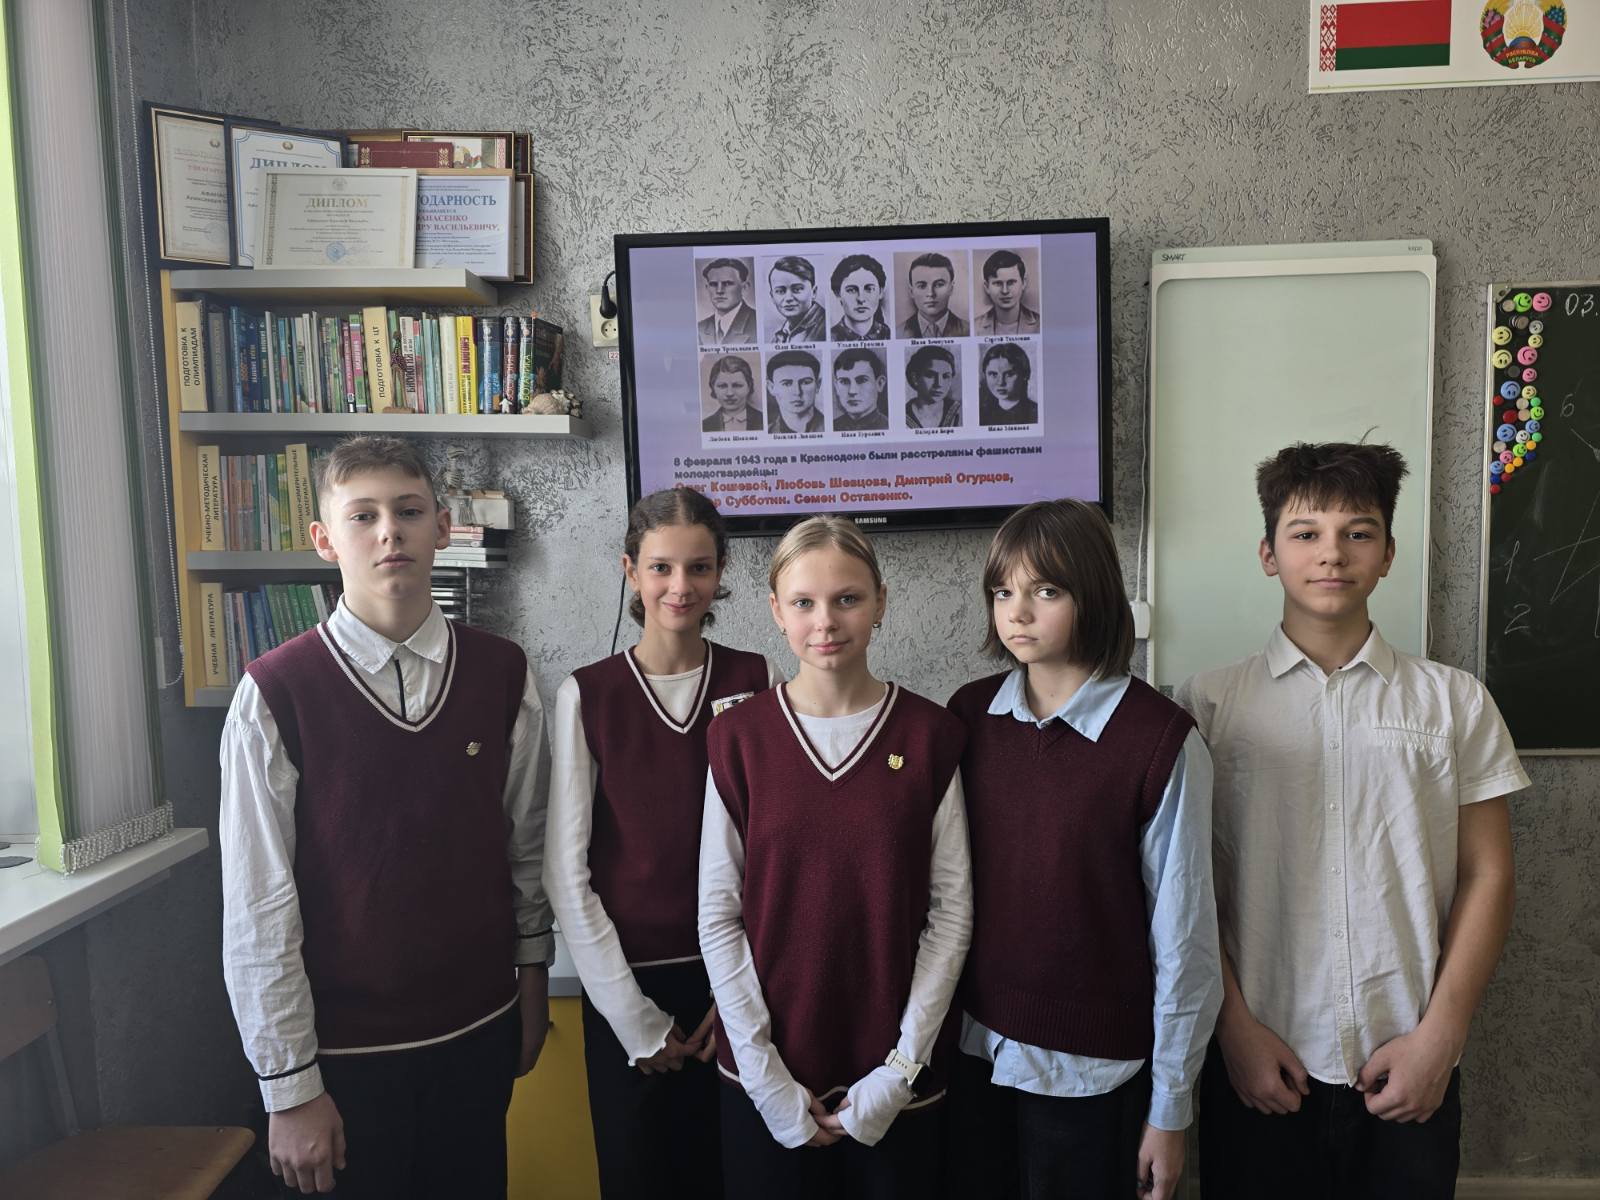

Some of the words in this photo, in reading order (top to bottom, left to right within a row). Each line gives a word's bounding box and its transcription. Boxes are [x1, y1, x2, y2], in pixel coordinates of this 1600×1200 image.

[249, 157, 328, 169] ДИПЛ
[305, 197, 369, 209] ДИПЛОМ
[417, 194, 497, 206] ОДАРНОСТЬ
[1161, 253, 1186, 262] SMART
[373, 326, 379, 336] ЦТ
[181, 335, 191, 387] ПОДГОТОВКА
[190, 327, 201, 386] ОЛИМПИАДАМ
[374, 347, 386, 398] ПОДГОТОВКА
[404, 353, 416, 393] БИОЛОГИЯ
[523, 354, 532, 401] БОТАНИКА
[673, 457, 680, 466] 8
[683, 455, 732, 468] февраля
[735, 454, 760, 465] 1943
[764, 455, 788, 466] года
[800, 452, 866, 464] Краснодоне
[868, 450, 898, 461] были
[901, 448, 973, 461] расстреляны
[976, 446, 1042, 458] фашистами
[674, 468, 778, 480] молодогвардейцы:
[711, 479, 772, 492] Кошевой,
[775, 478, 826, 490] Любовь
[830, 476, 891, 489] Шевцова,
[895, 473, 952, 487] Дмитрий
[956, 471, 1014, 485] Огурцов,
[201, 453, 212, 543] УЧЕБНО-МЕТОДИЧЕСКАЯ
[212, 475, 220, 521] ЛИТЕРАТУРА
[302, 477, 311, 517] МАТЕРИАЛЫ
[725, 495, 790, 508] Субботин.
[794, 493, 836, 504] Семен
[840, 490, 913, 503] Остапенко.
[854, 516, 887, 525] SAMSUNG
[207, 593, 216, 639] ЛИТЕРАТУРА
[1503, 602, 1532, 635] 2
[210, 643, 219, 675] УЧЕБНАЯ
